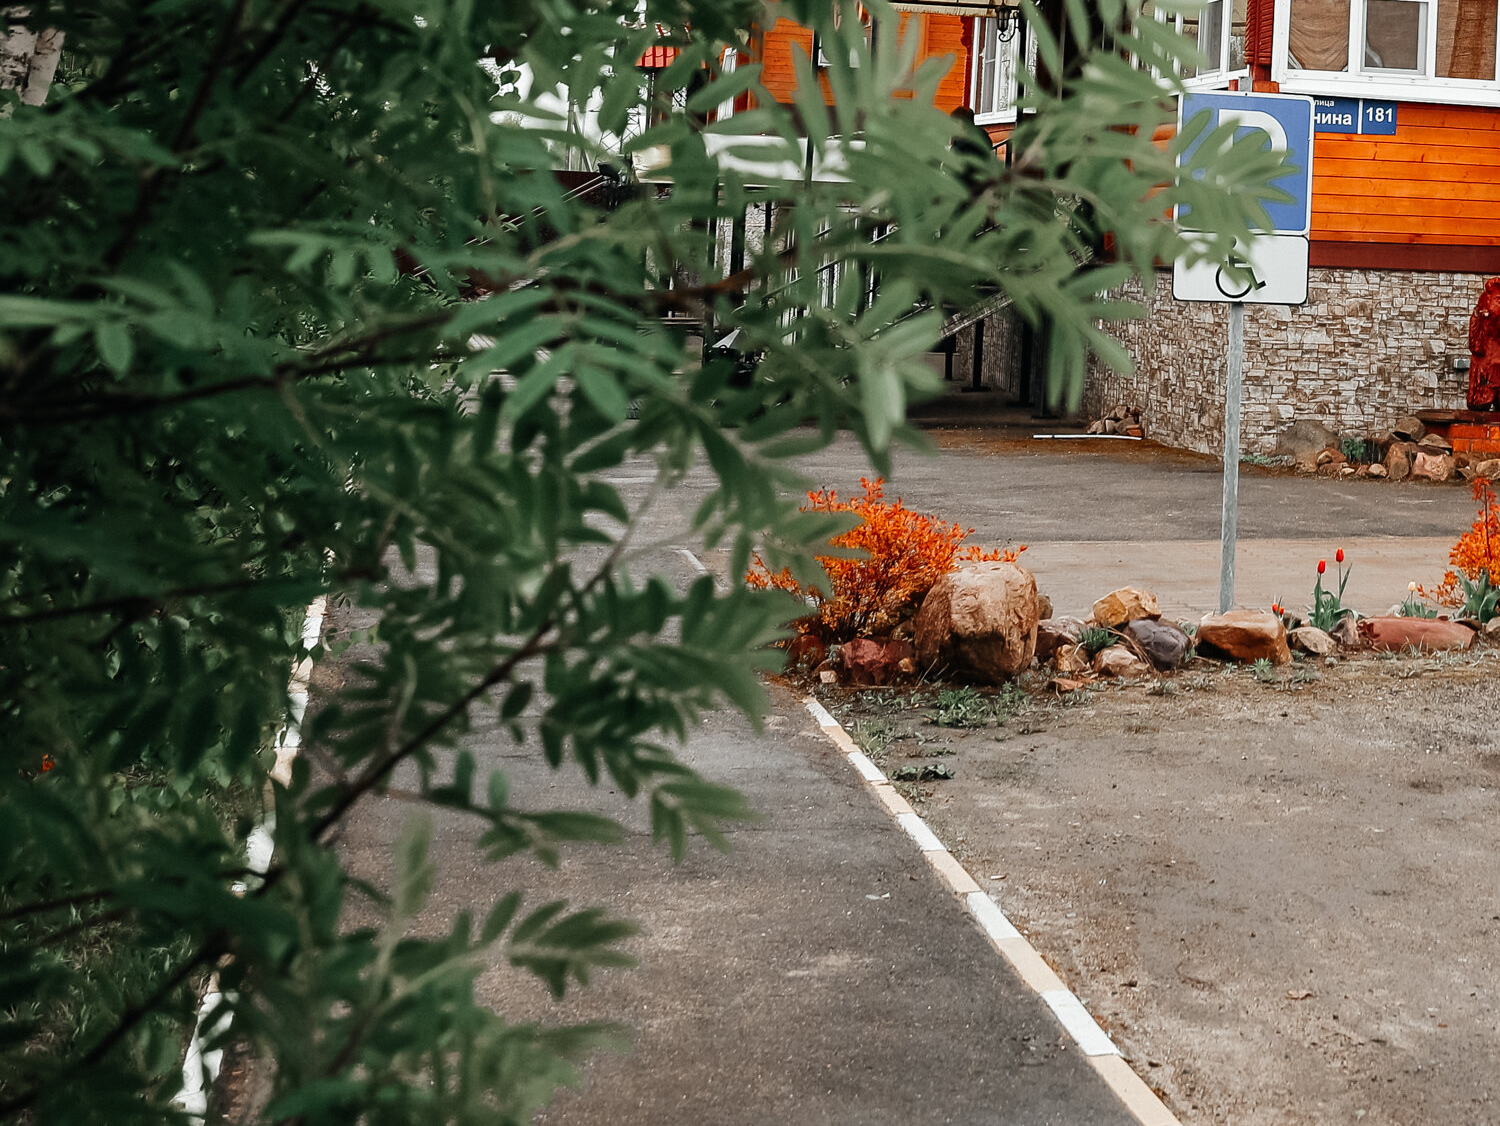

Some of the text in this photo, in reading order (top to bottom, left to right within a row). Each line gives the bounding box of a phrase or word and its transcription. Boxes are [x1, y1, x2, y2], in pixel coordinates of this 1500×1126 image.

[1314, 99, 1335, 108] лица
[1314, 112, 1352, 126] нина
[1366, 106, 1393, 123] 181
